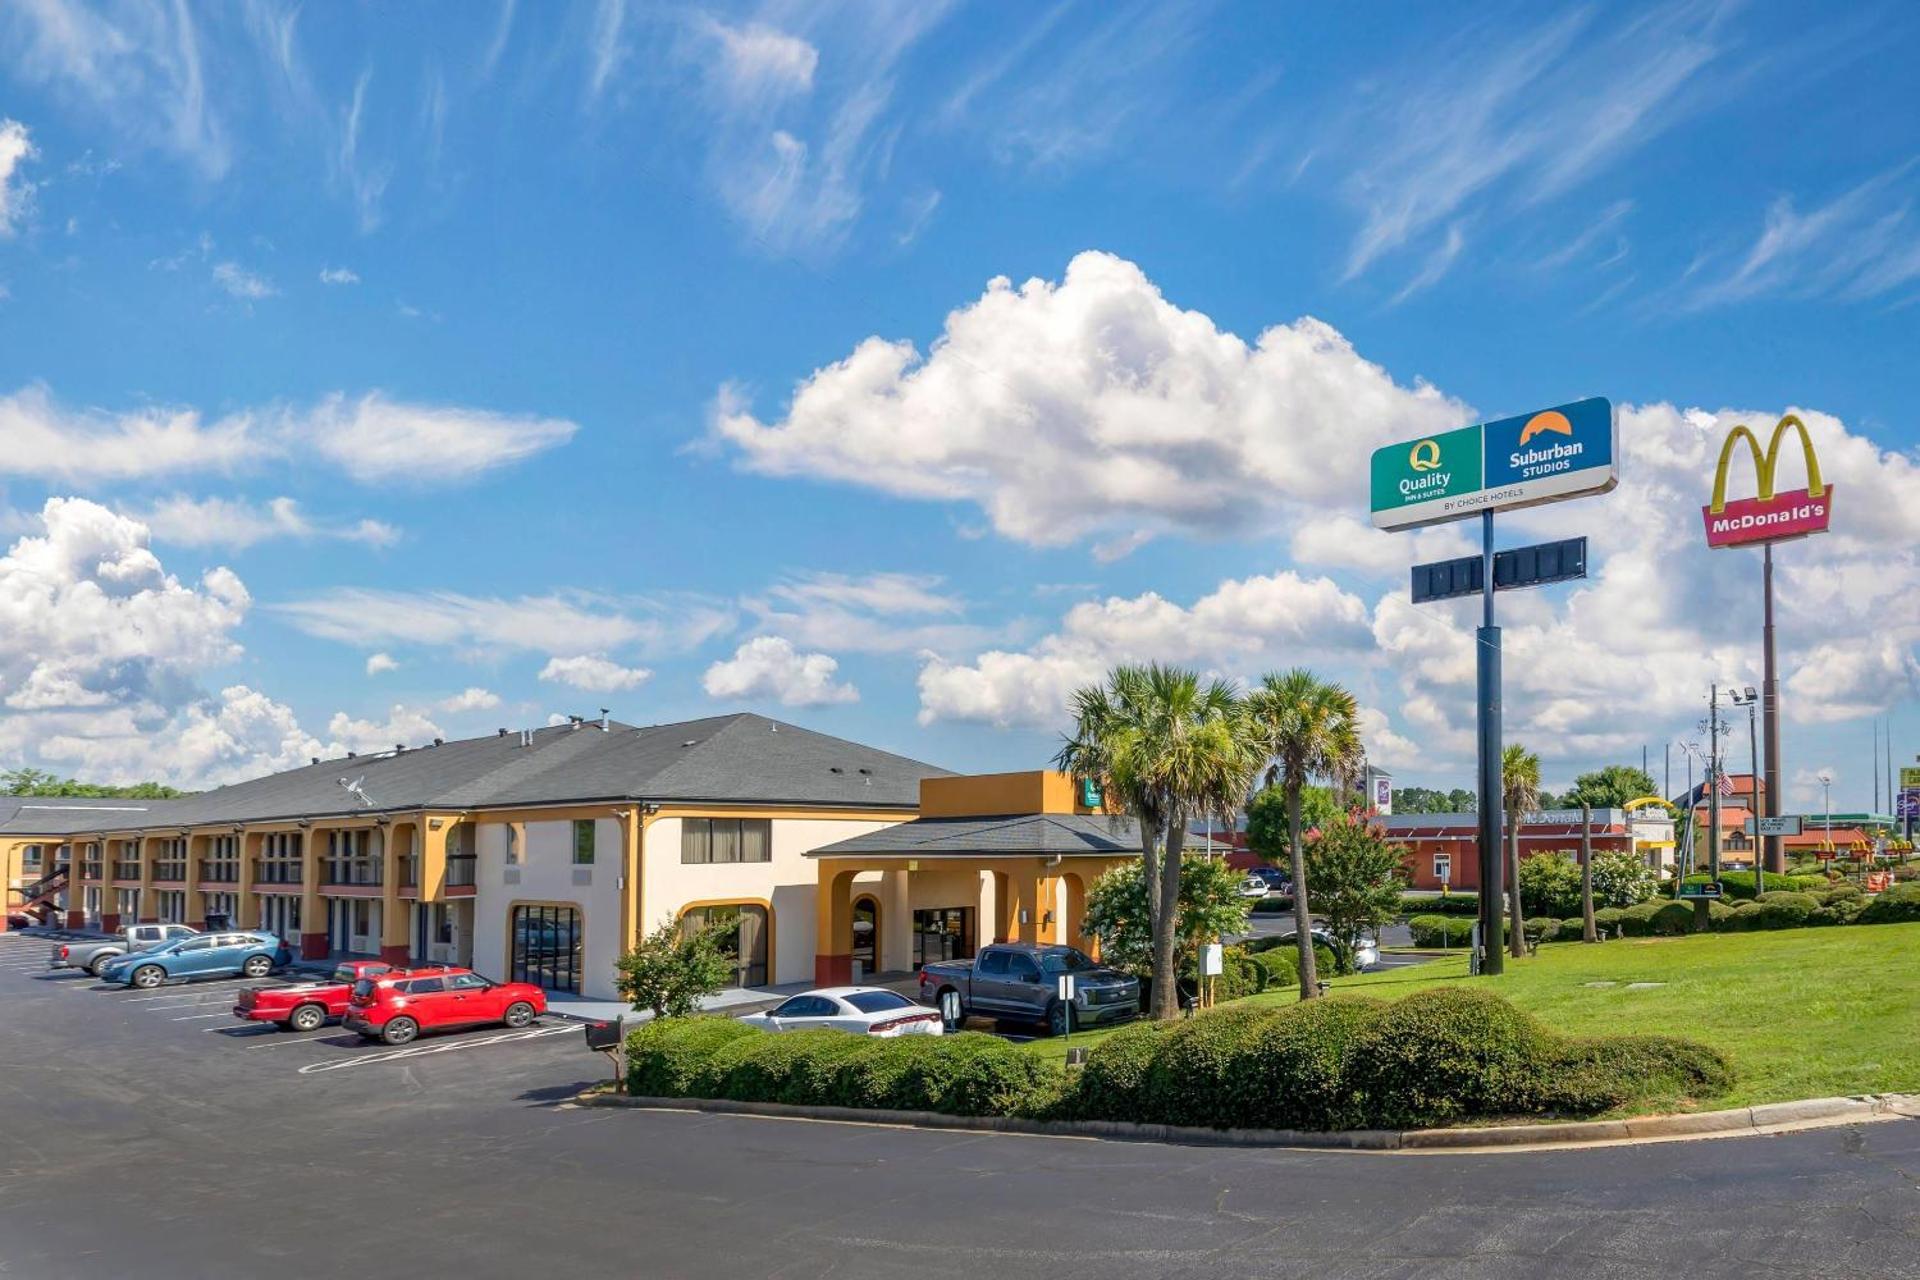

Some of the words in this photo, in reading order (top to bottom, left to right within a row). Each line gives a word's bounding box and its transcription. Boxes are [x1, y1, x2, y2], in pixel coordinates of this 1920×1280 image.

[1509, 442, 1583, 468] Suburban
[1522, 459, 1570, 478] STUDIOS
[1399, 472, 1451, 495] Quality
[1404, 494, 1417, 503] INN
[1422, 488, 1446, 499] SUITES
[1444, 502, 1455, 511] BY
[1457, 495, 1489, 508] CHOICE
[1490, 489, 1524, 501] HOTELS
[1712, 504, 1825, 533] McDonald's
[1522, 810, 1595, 825] McDonalds
